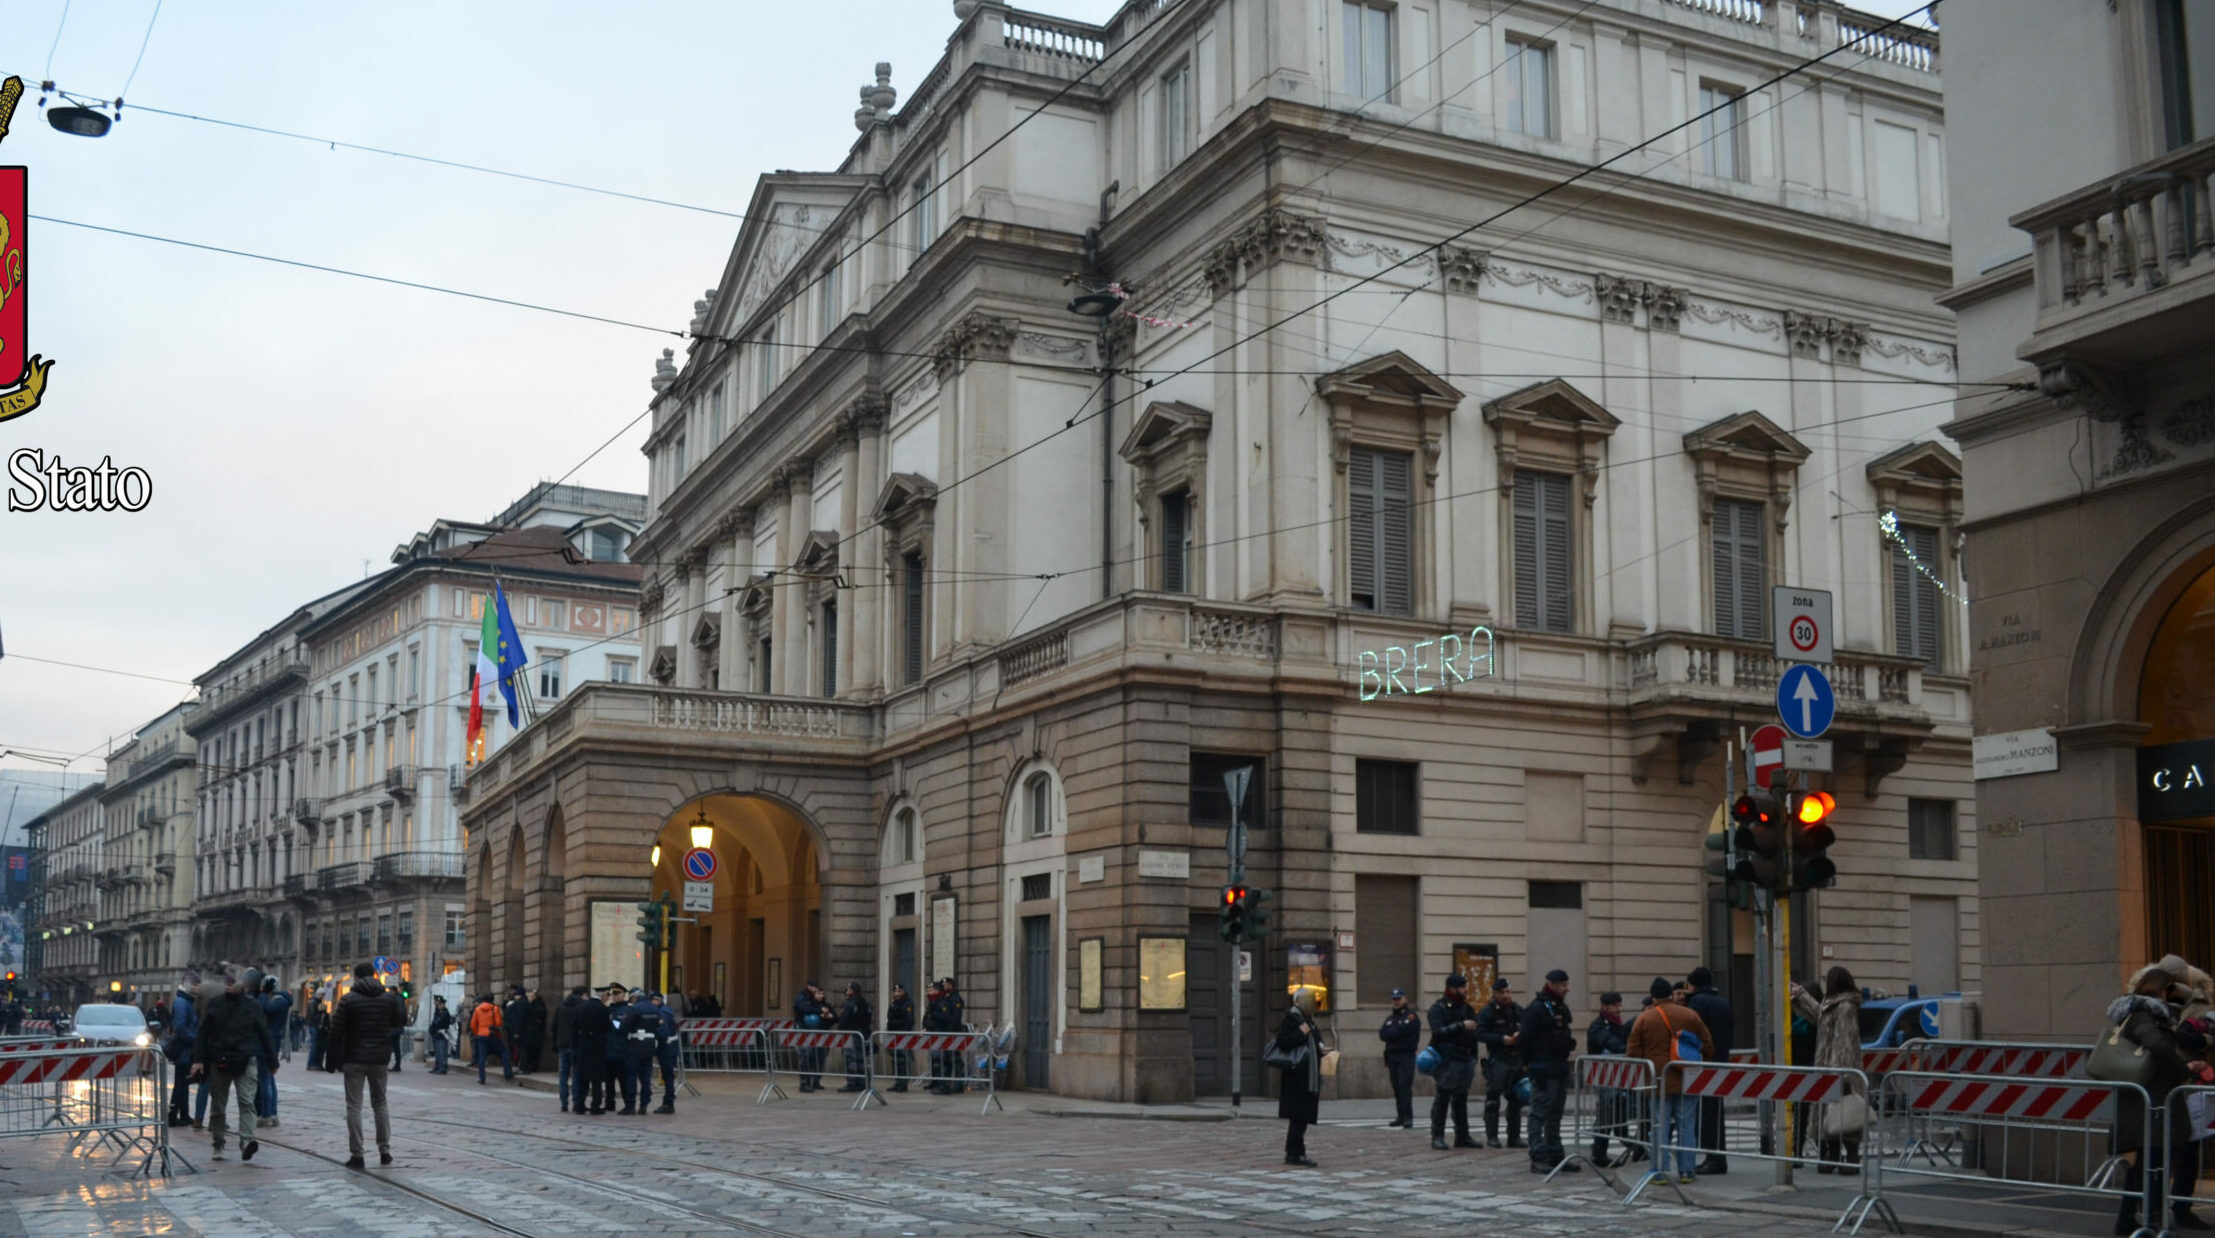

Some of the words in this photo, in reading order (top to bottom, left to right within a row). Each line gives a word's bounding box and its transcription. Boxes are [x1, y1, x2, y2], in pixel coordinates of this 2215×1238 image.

[1792, 596, 1814, 608] zona
[1796, 626, 1812, 641] 30
[1359, 625, 1494, 702] BRERA
[2005, 735, 2019, 745] VIA
[2010, 744, 2054, 761] MANZONI
